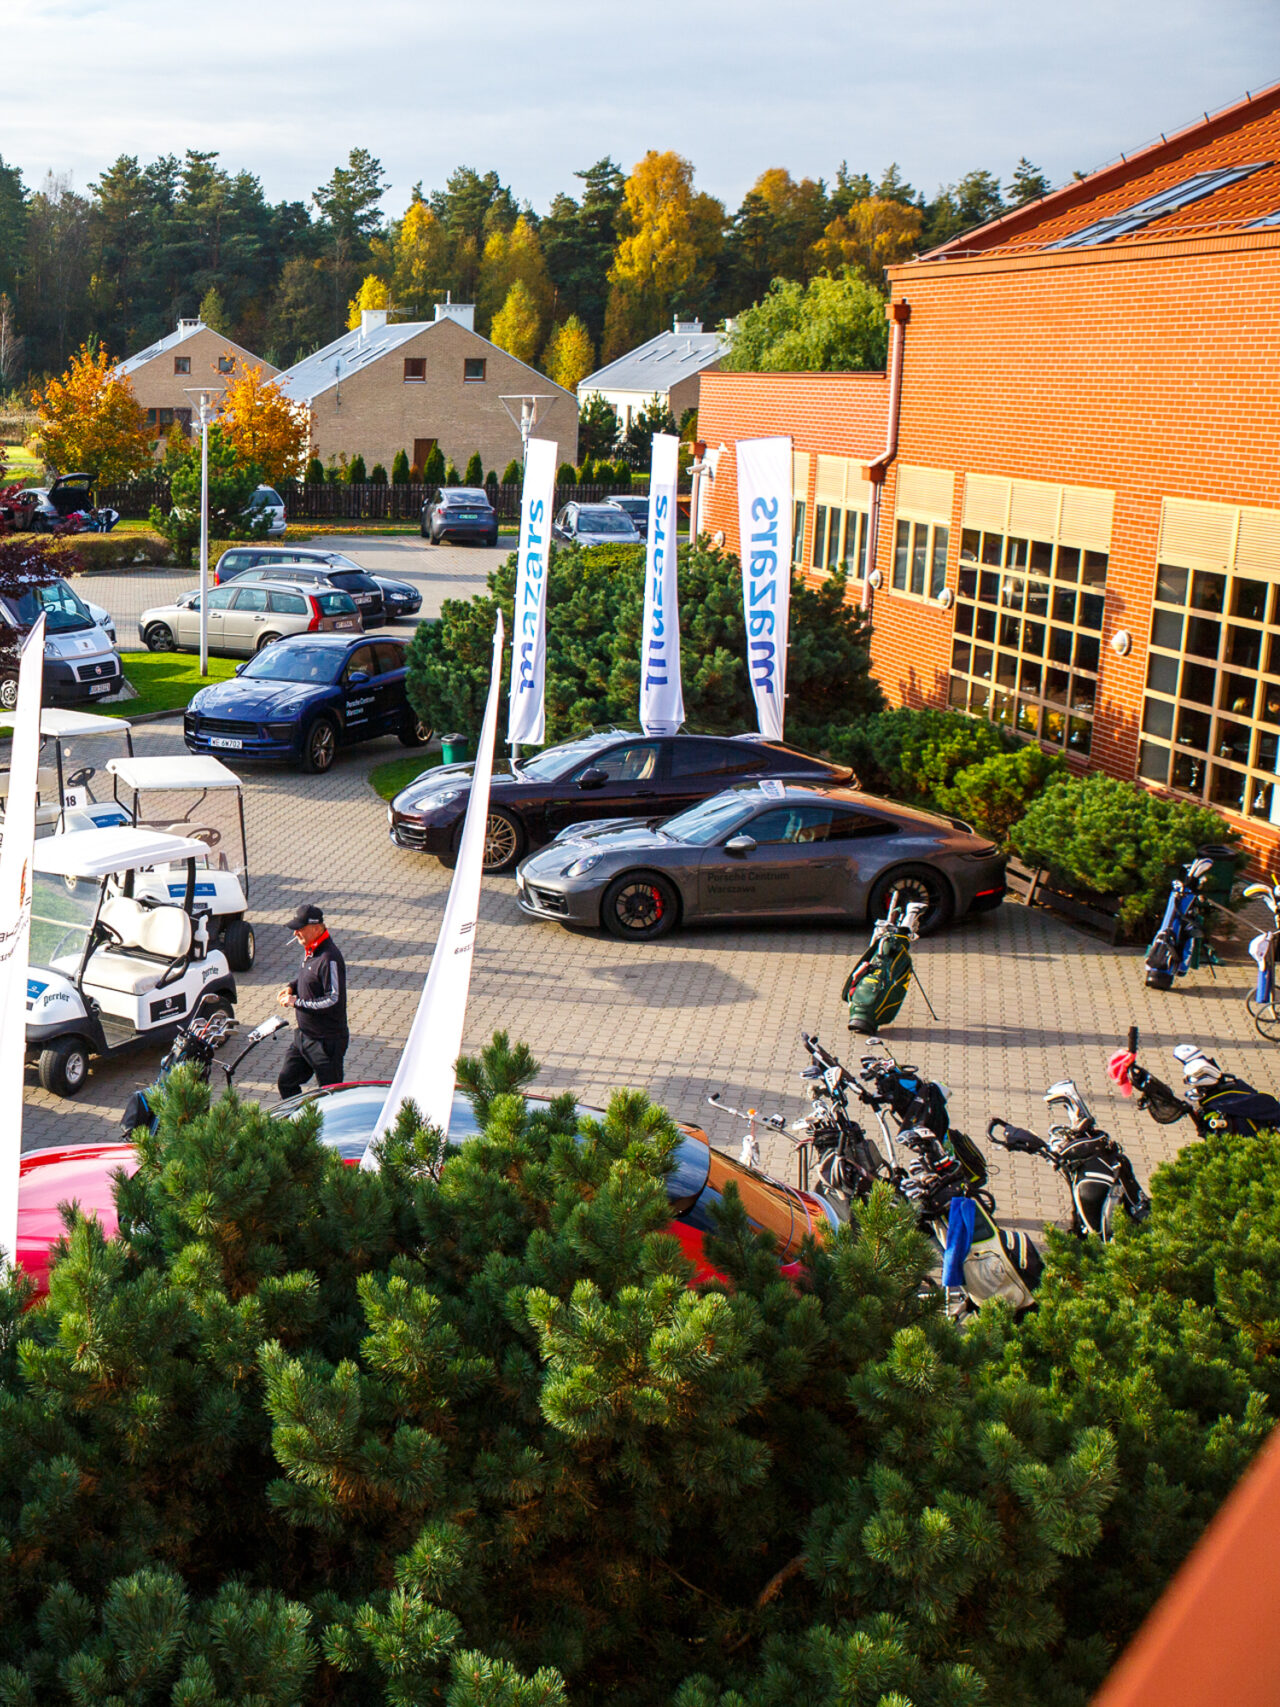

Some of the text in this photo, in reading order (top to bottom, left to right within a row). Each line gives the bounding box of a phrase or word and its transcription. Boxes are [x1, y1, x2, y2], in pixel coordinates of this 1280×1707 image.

[519, 498, 544, 694] mazars
[645, 494, 669, 692] mazars
[65, 795, 77, 807] 18
[44, 991, 70, 1007] perrier
